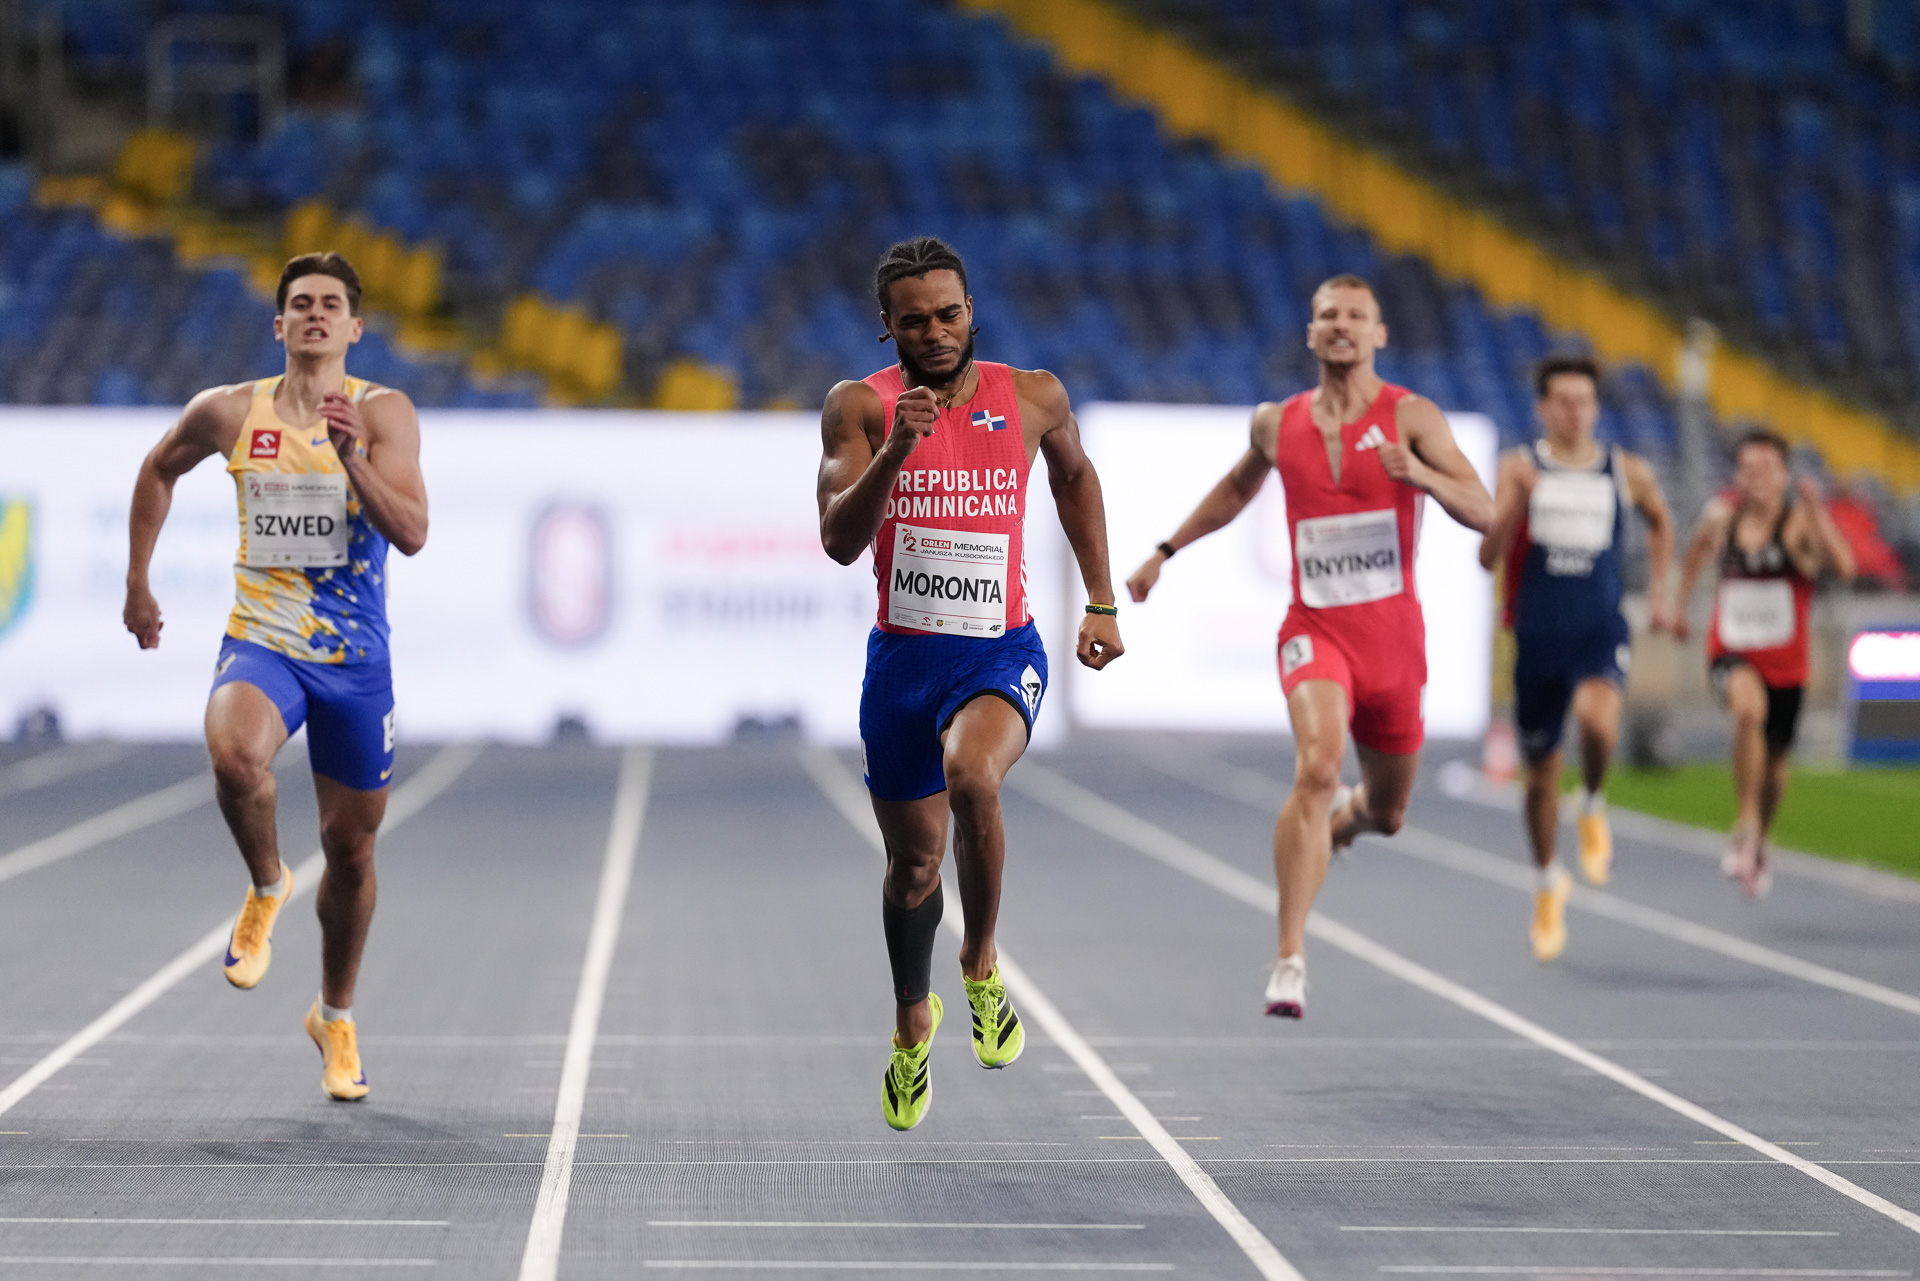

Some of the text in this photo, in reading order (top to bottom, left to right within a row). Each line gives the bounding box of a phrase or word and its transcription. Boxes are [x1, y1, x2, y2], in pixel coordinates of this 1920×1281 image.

[898, 468, 1018, 492] REPUBLICA
[254, 514, 335, 536] SZWED
[920, 549, 953, 557] JANUSZA
[922, 539, 950, 549] ORLEN
[1304, 549, 1395, 579] ENYINGI
[894, 568, 1003, 604] MORONTA
[1286, 639, 1303, 667] 3
